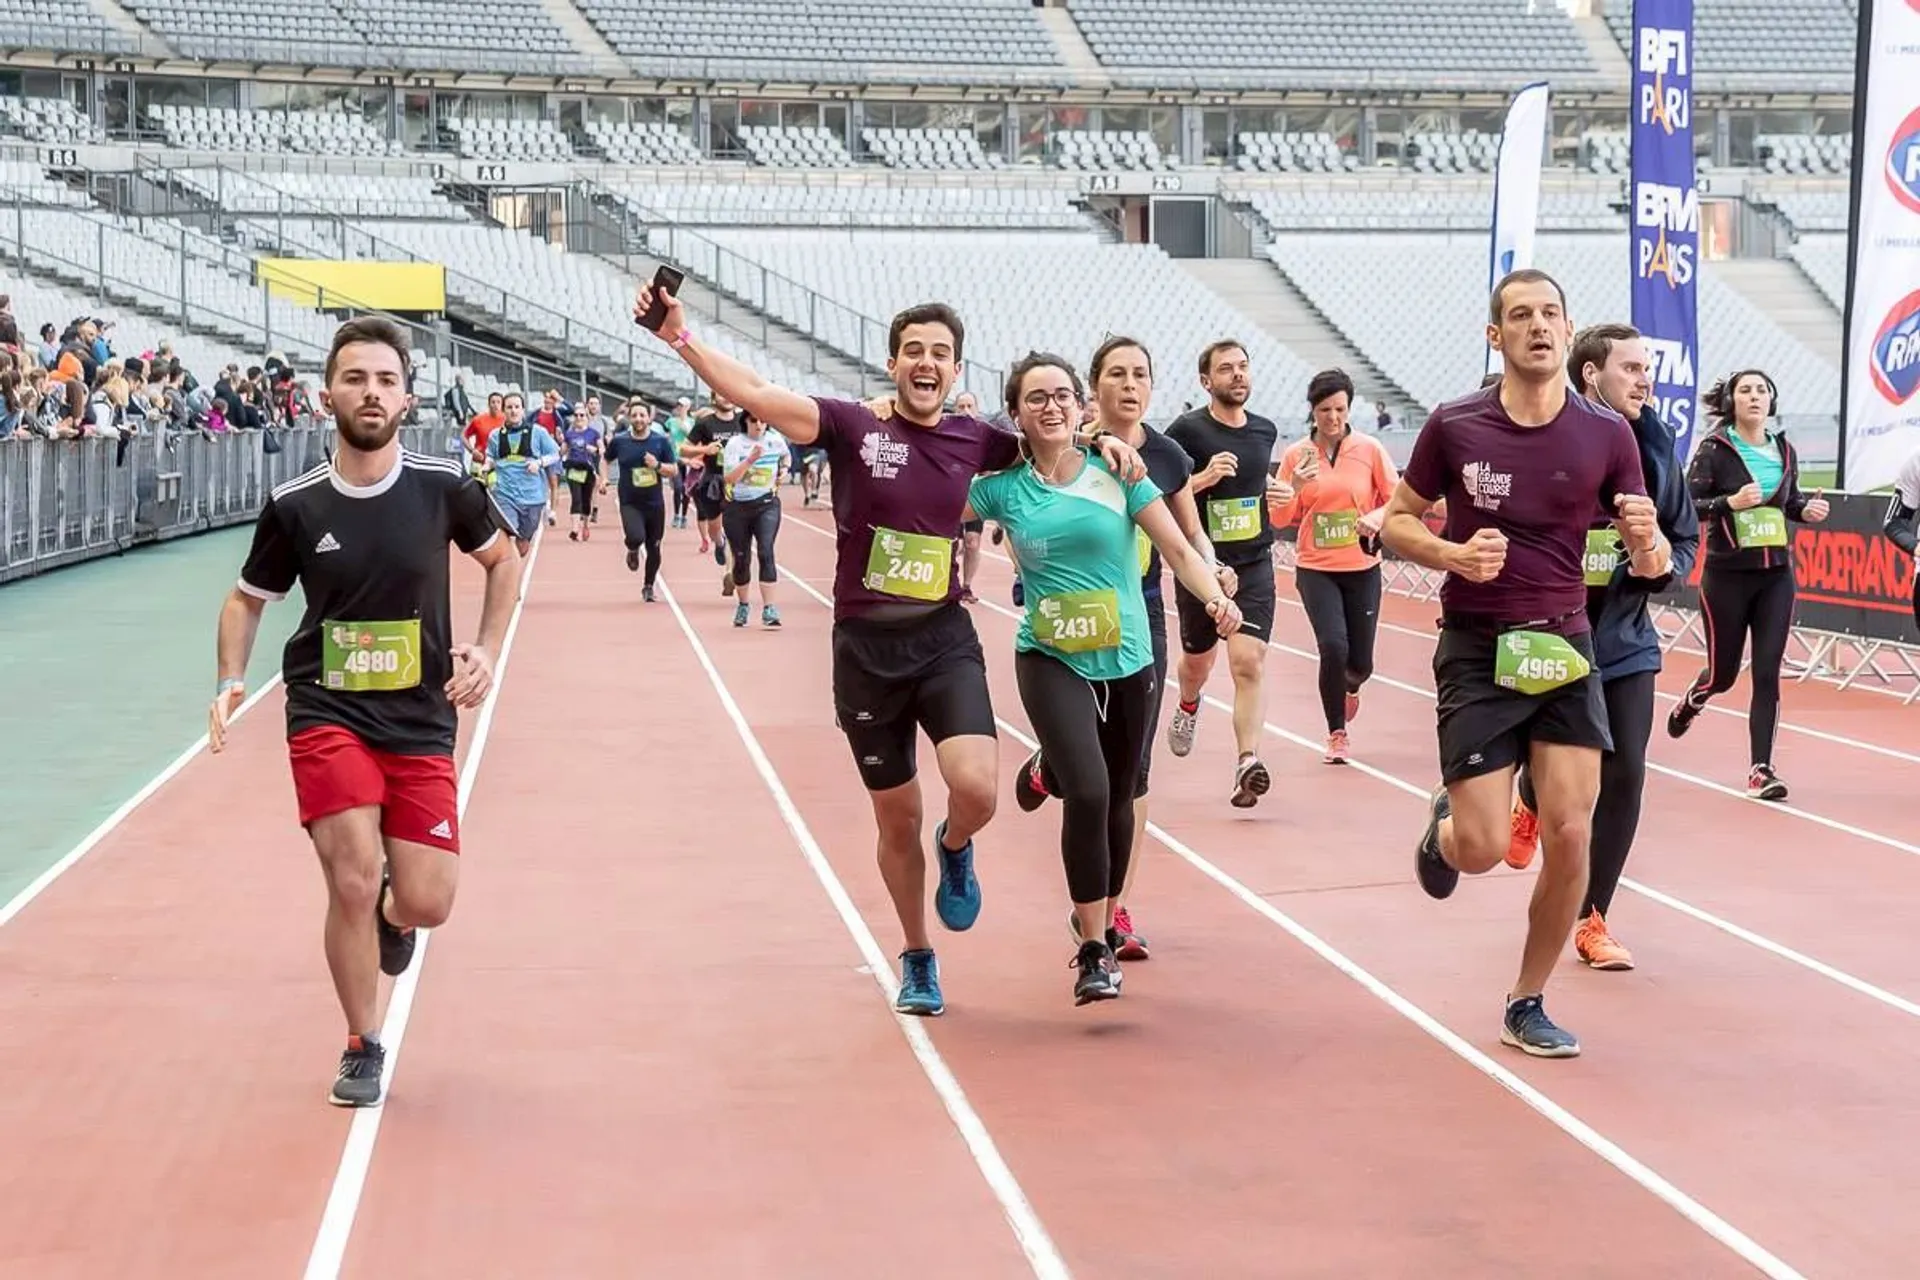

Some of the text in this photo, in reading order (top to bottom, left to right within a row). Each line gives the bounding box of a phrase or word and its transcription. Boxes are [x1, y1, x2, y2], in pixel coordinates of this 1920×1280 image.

[1645, 336, 1695, 387] FM
[880, 432, 890, 441] LA
[880, 442, 909, 456] GRANDE
[878, 451, 909, 466] COURSE
[1480, 460, 1490, 471] LA
[1479, 471, 1512, 484] GRANDE
[1479, 483, 1511, 496] COURSE
[886, 557, 934, 584] 2430
[1052, 615, 1098, 640] 2431
[343, 649, 398, 674] 4980
[1516, 656, 1568, 682] 4965
